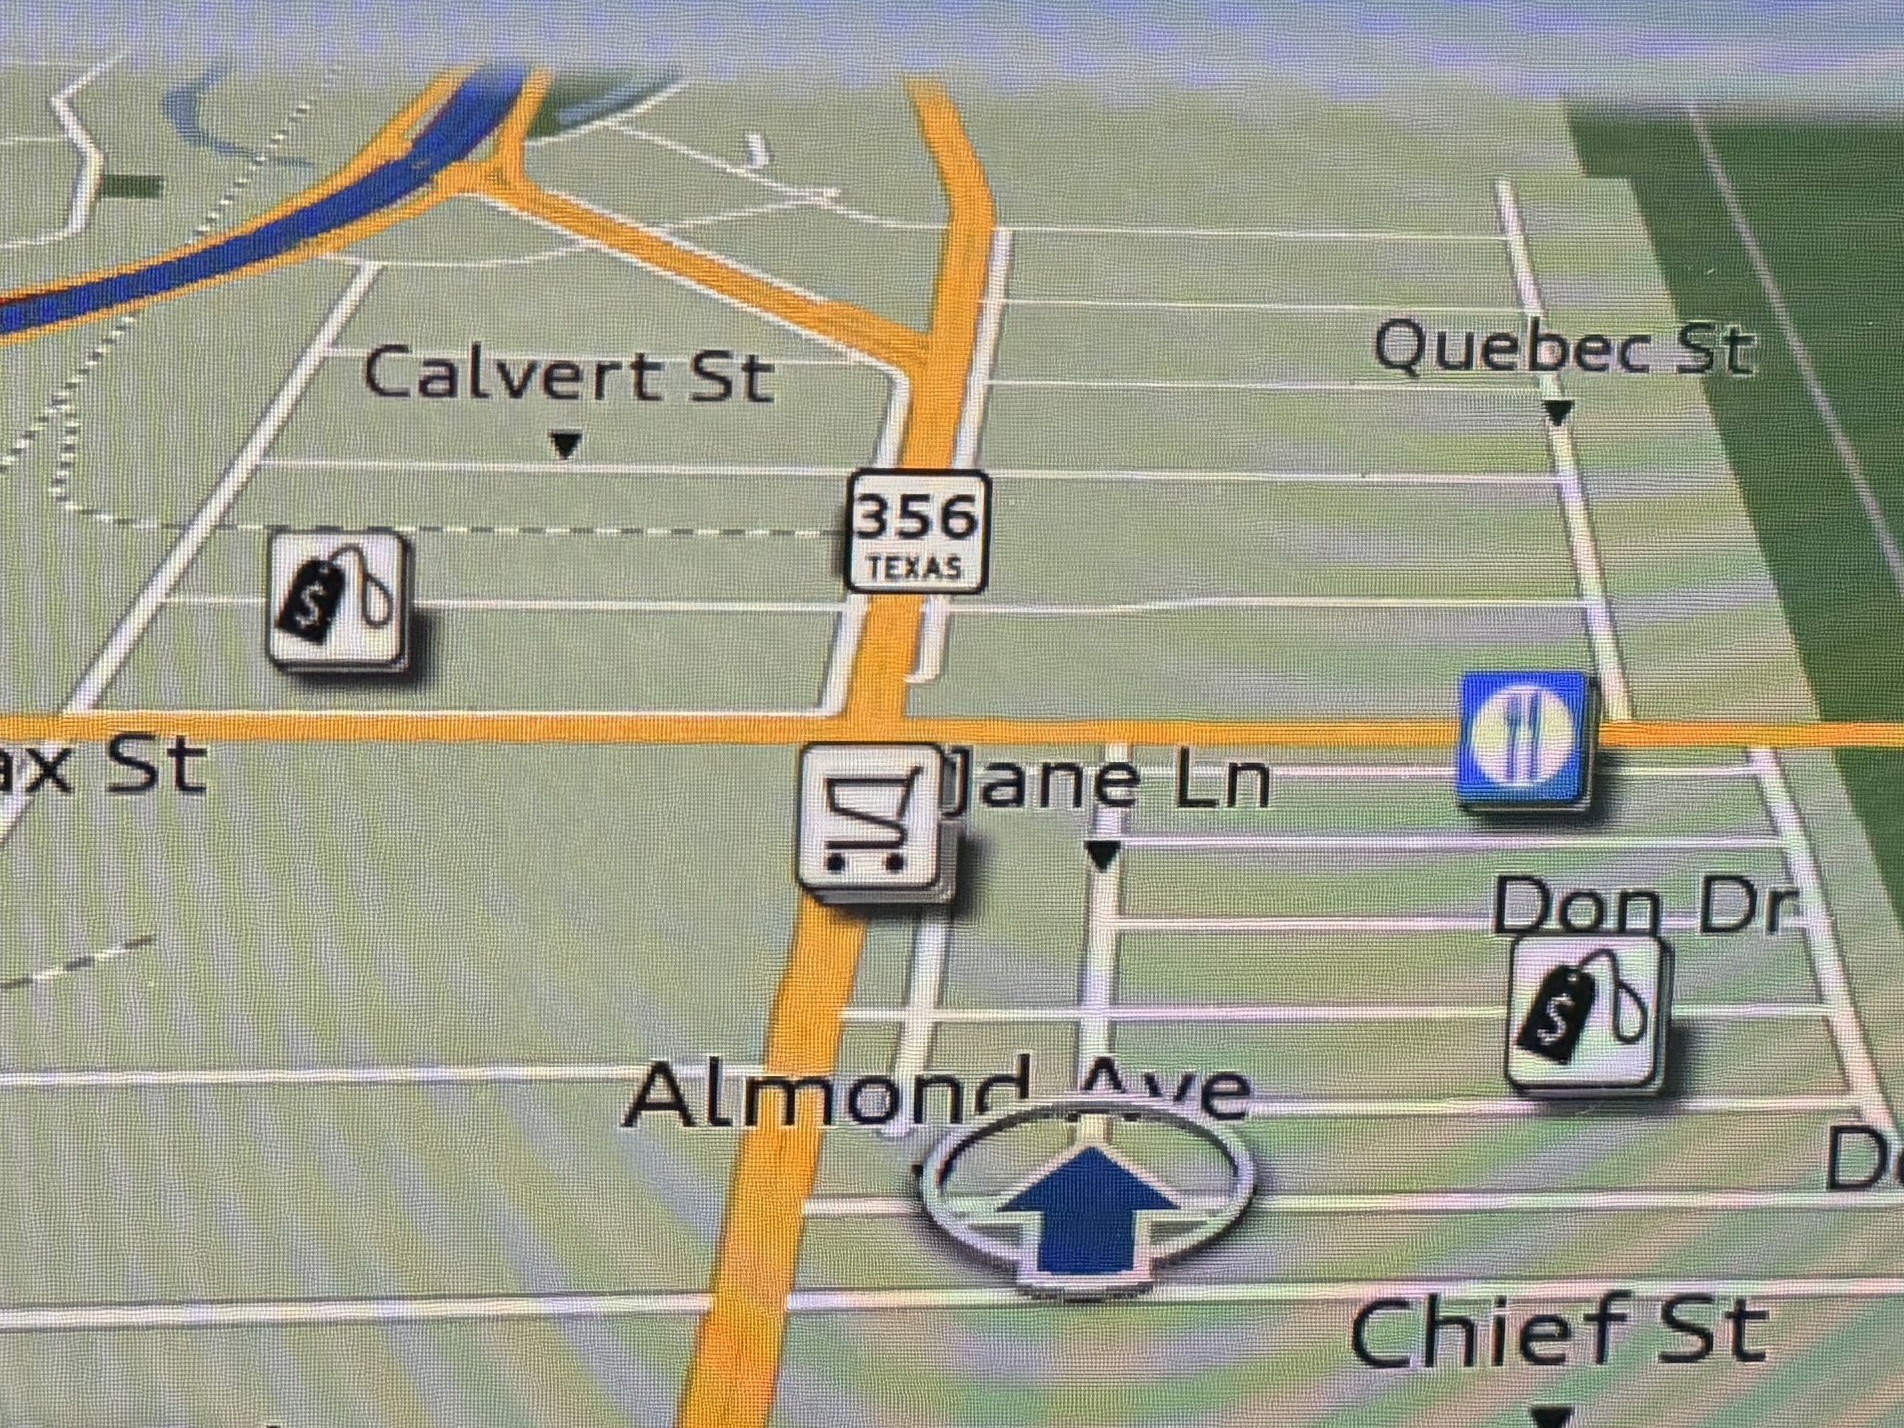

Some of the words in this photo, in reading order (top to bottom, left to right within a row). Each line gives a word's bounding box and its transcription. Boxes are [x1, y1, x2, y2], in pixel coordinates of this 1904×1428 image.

[365, 342, 663, 402] Calvert
[690, 350, 774, 403] St
[1374, 316, 1651, 377] Quebec
[1675, 320, 1757, 375] St
[852, 494, 980, 541] 356
[866, 554, 962, 581] TEXAS
[105, 730, 208, 796] St
[942, 746, 1141, 818] Jane
[1178, 746, 1272, 808] Ln
[1495, 875, 1662, 936] Don
[1700, 875, 1799, 934] Dr
[620, 1053, 1032, 1128] Almond
[1067, 1054, 1251, 1121] Ave
[1352, 1289, 1633, 1370] Chief
[1659, 1295, 1769, 1364] St
